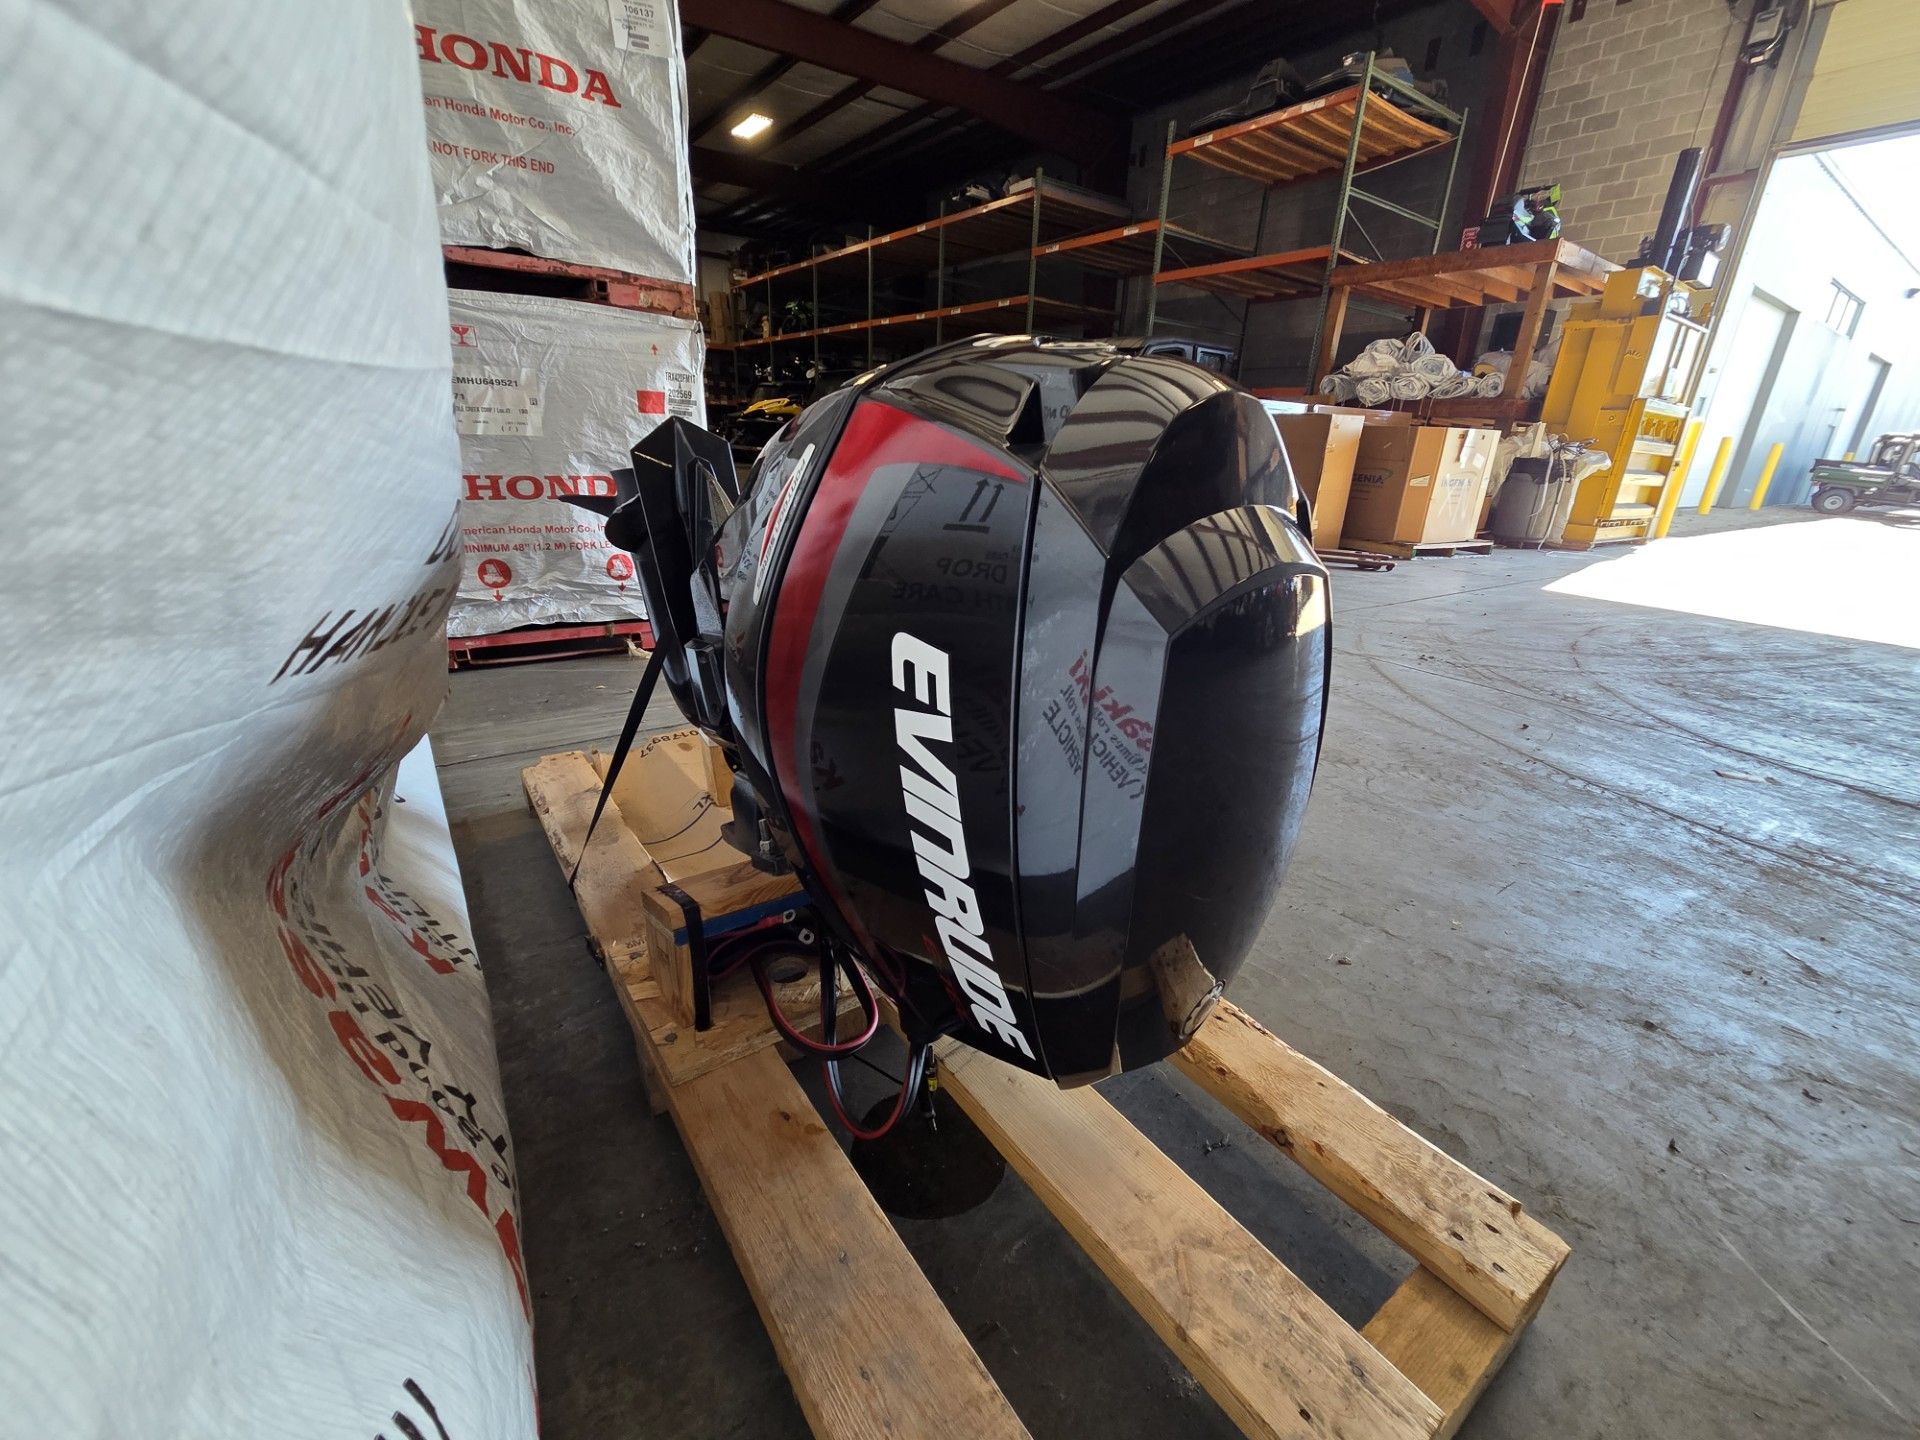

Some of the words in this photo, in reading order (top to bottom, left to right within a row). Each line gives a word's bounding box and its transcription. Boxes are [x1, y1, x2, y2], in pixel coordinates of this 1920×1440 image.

[414, 23, 622, 108] HONDA
[444, 97, 486, 117] Honda
[489, 107, 526, 126] Motor
[432, 140, 460, 157] NOT
[463, 147, 498, 164] FORK
[501, 153, 527, 169] THIS
[530, 158, 555, 174] END
[462, 474, 618, 501] HOND
[463, 525, 506, 536] merican
[508, 525, 542, 535] Honda
[544, 525, 575, 535] Motor
[569, 541, 597, 551] FORK
[891, 631, 1037, 1062] EVINRUDE
